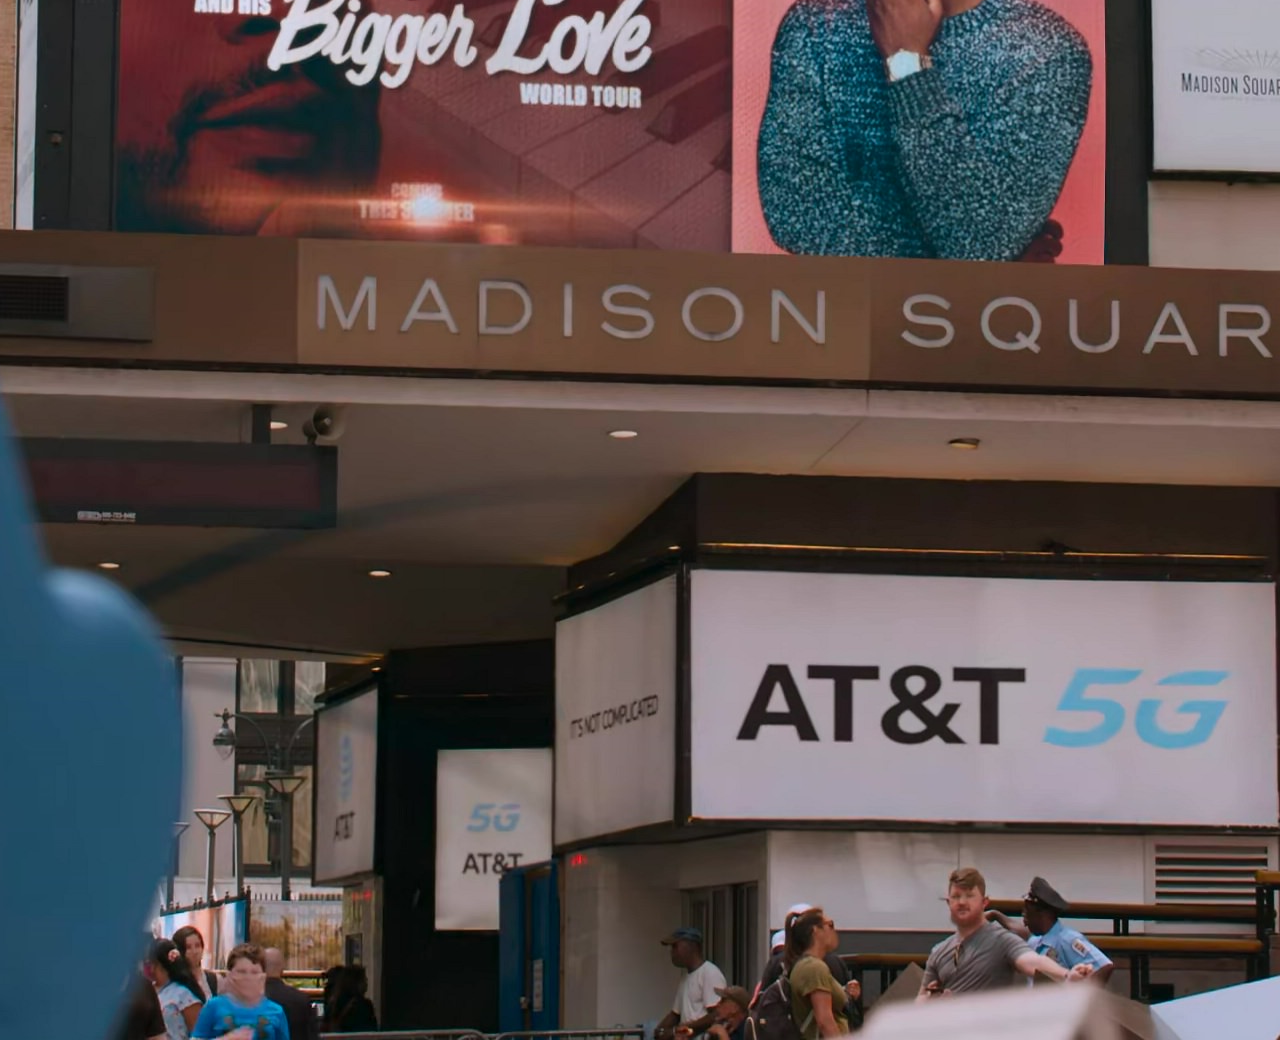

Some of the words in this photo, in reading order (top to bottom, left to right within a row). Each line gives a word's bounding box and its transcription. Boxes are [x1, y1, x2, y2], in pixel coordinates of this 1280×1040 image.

[520, 82, 588, 107] WORLD
[592, 85, 642, 109] TOUR
[1180, 72, 1238, 94] MADISON
[317, 275, 826, 344] MADISON
[735, 662, 1027, 746] AT&T
[1042, 667, 1231, 750] 5G
[466, 803, 521, 833] 5G
[462, 852, 524, 875] AT&T
